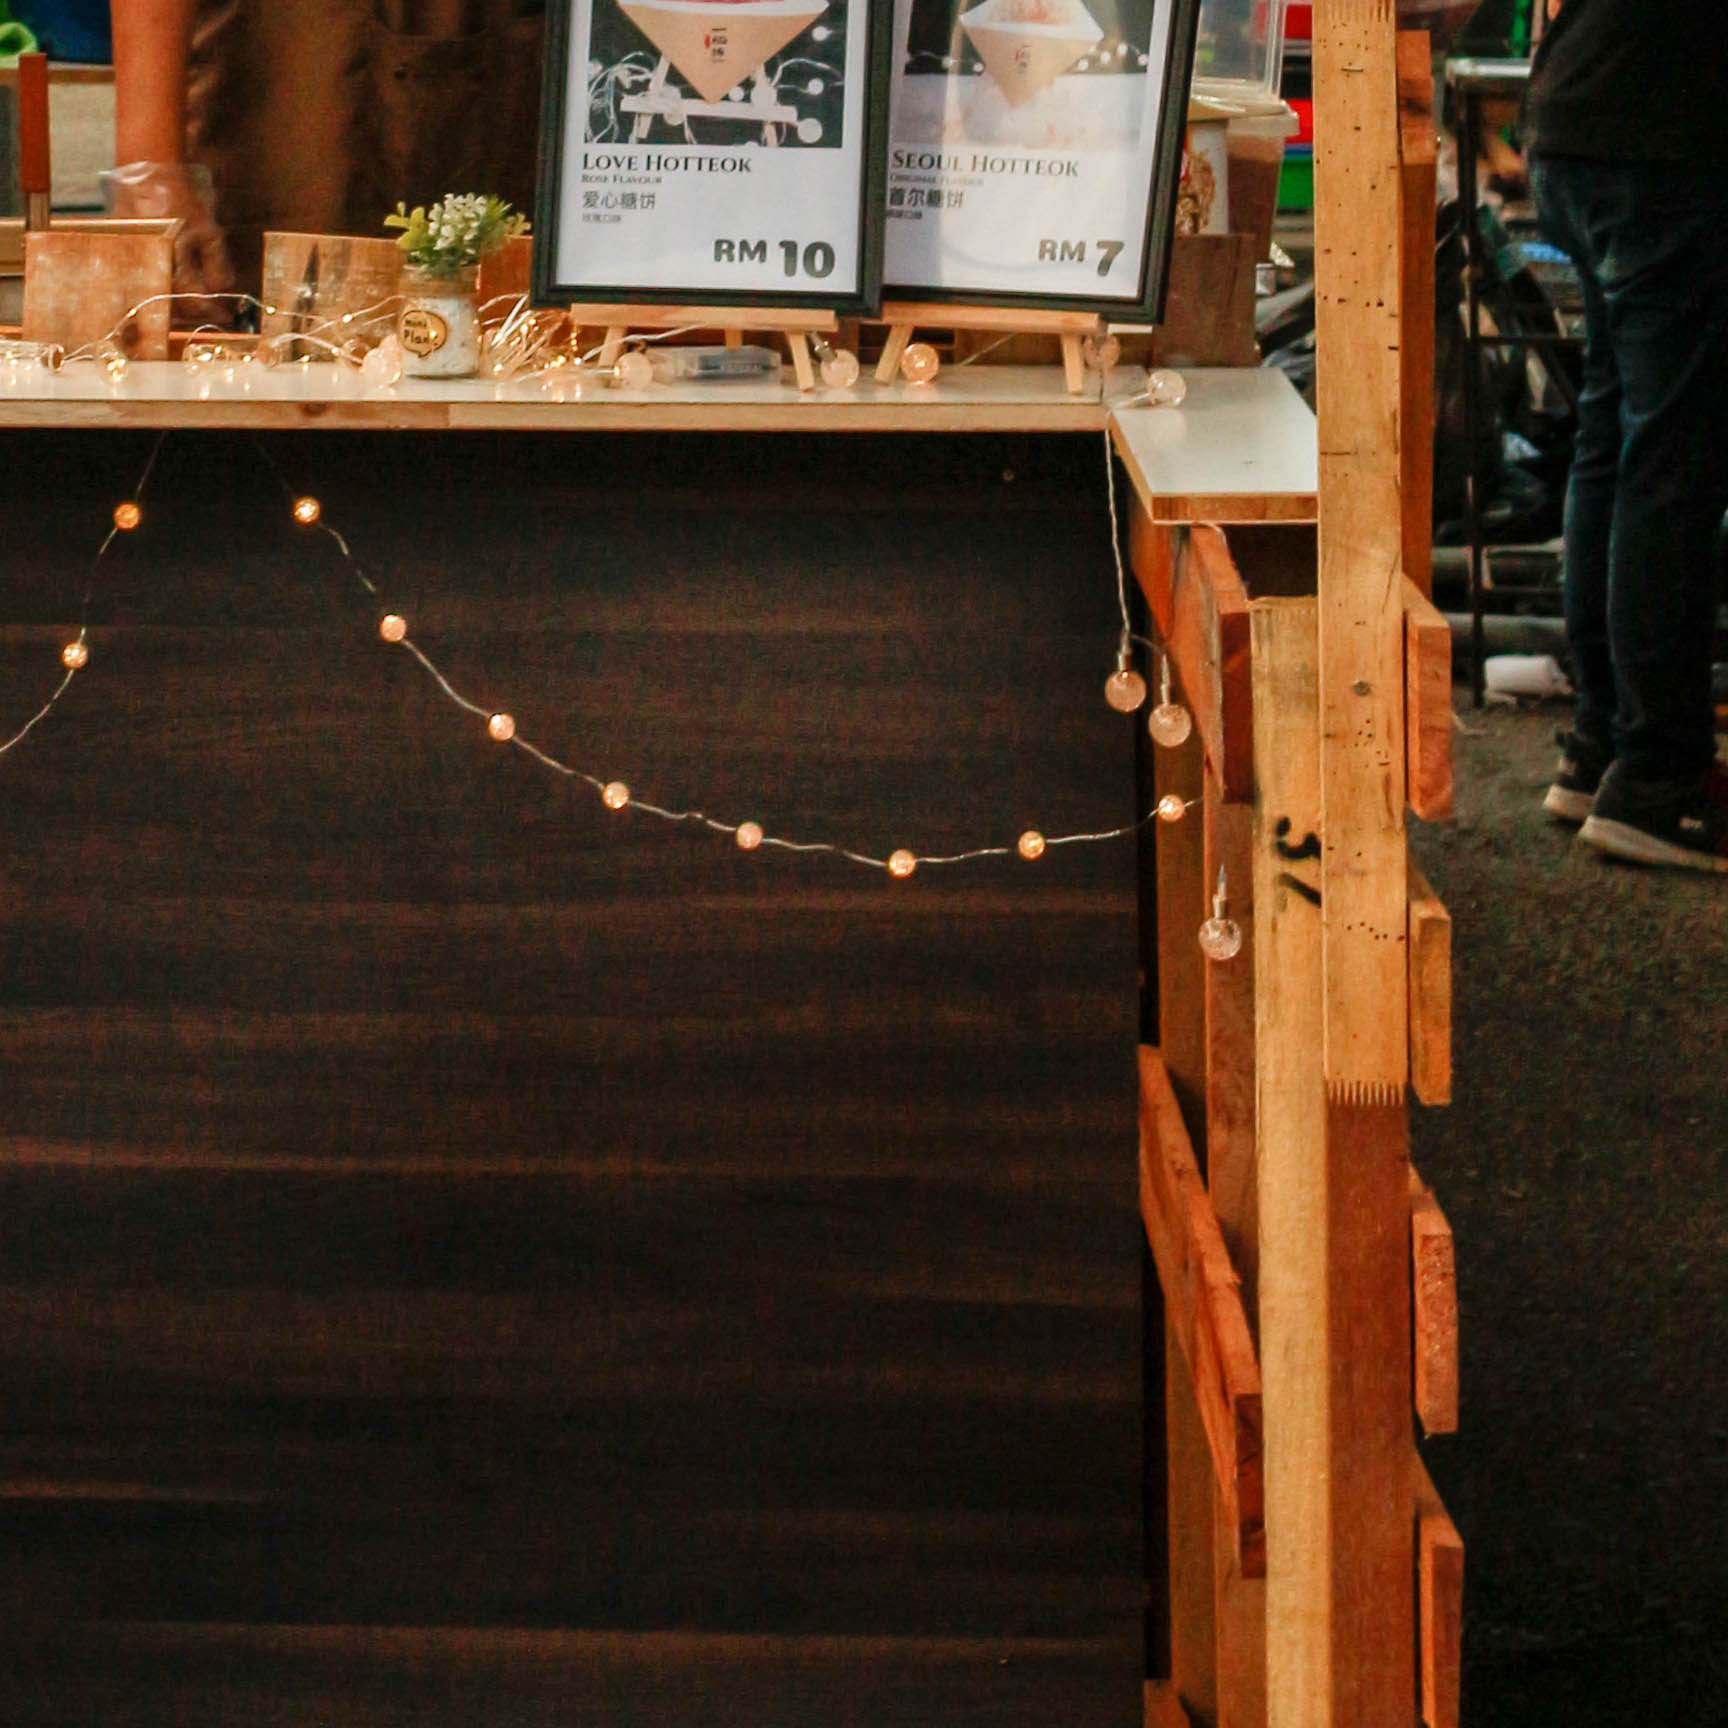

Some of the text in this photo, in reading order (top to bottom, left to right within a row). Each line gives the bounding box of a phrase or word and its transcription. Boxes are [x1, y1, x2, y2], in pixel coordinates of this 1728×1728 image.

[582, 152, 752, 173] LOVE HOTTEOK
[891, 148, 1080, 178] SEOUL HOTTEOK
[713, 238, 836, 279] RM 10
[1037, 238, 1126, 277] RM 7
